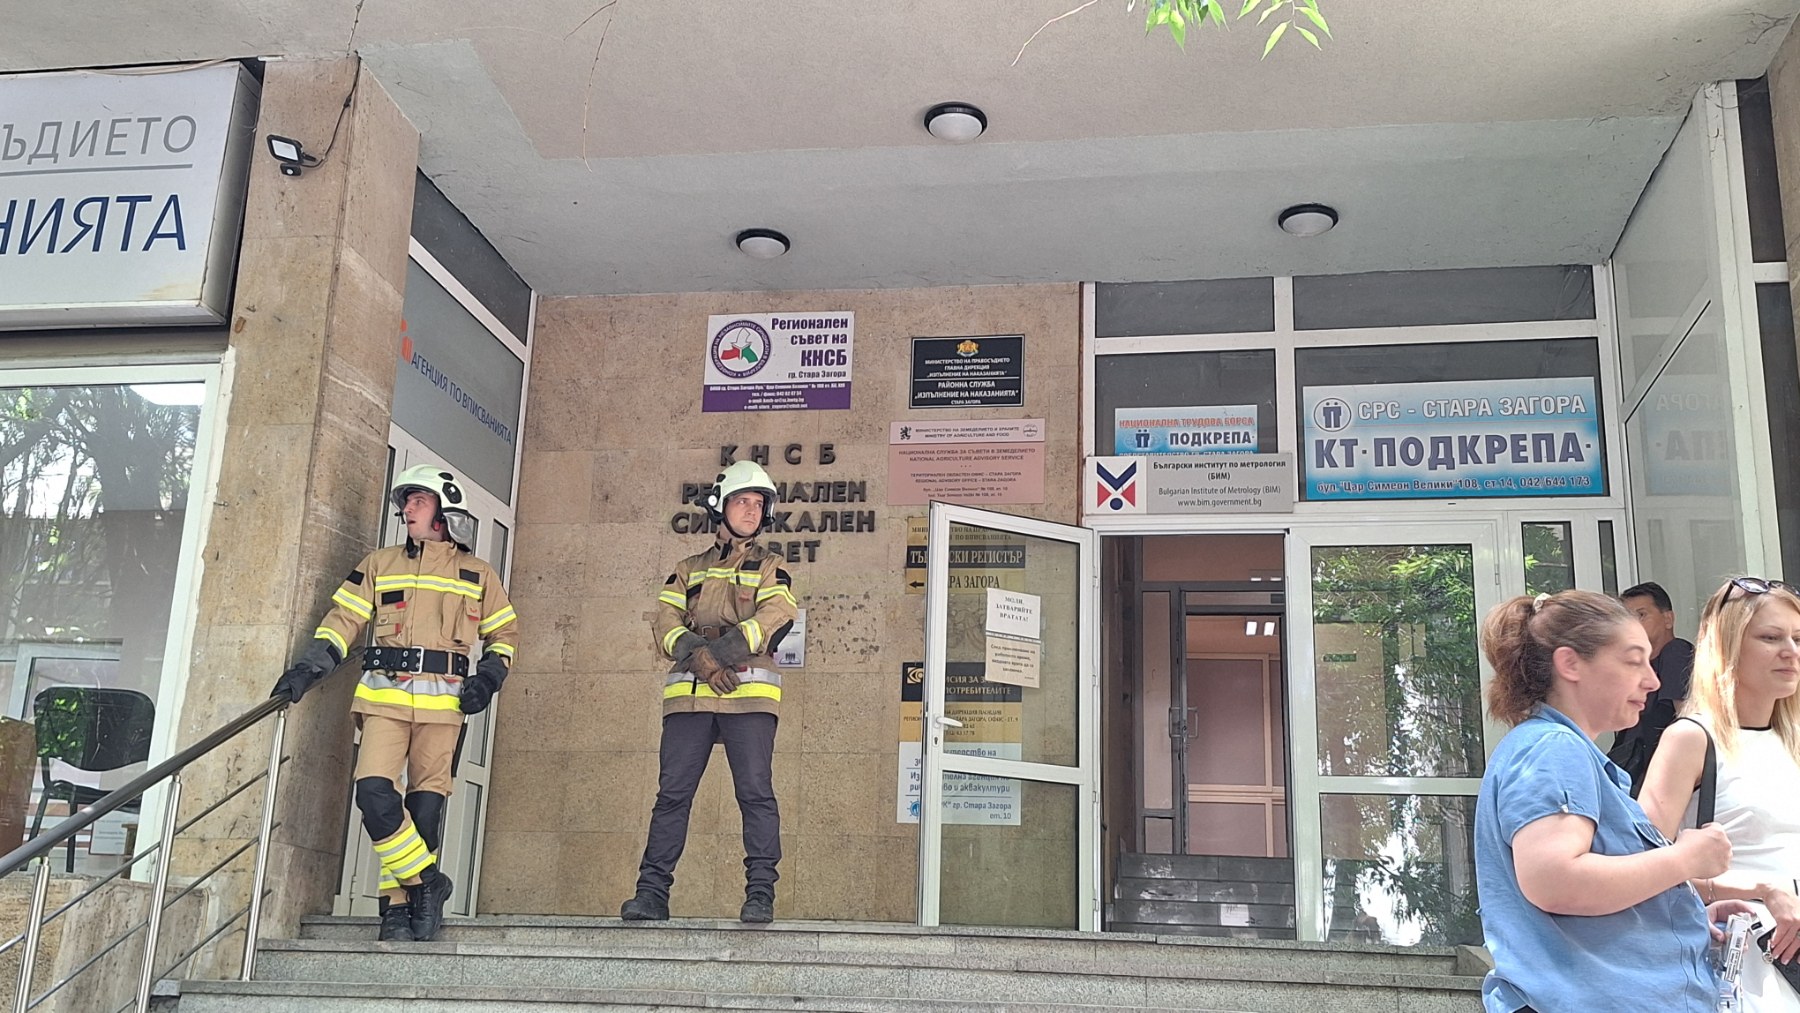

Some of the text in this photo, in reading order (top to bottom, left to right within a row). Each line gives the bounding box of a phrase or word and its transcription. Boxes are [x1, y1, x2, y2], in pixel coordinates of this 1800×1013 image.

[771, 317, 849, 330] Регионален
[790, 333, 848, 345] съвет на
[800, 349, 847, 367] КНСБ
[821, 370, 847, 378] Загора
[938, 381, 968, 389] РАЙОННА
[411, 352, 512, 445] АГЕНЦИЯ ПО ВПИСВАНИЯТА
[1357, 401, 1401, 420] СРС
[1423, 397, 1493, 418] СТАРА
[1498, 394, 1586, 416] ЗАГОРА
[1119, 416, 1255, 429] НАЦИОНАЛНА ТРУДОВА БОРСА
[1153, 462, 1193, 471] Български
[1194, 462, 1228, 470] институт
[1240, 460, 1286, 470] метрология
[1208, 472, 1230, 481] (БИМ)
[1367, 480, 1410, 491] Симеон
[1569, 476, 1590, 486] 173
[1158, 486, 1281, 497] Bulgarian Institute of Metrology (BIM)
[1177, 498, 1262, 508] www.bim.government.bg
[971, 550, 1023, 563] РЕГИСТЪР
[964, 575, 1000, 588] ЗАГОРА
[968, 676, 979, 684] ЗА
[960, 783, 1010, 794] аквакултури
[963, 802, 986, 810] Стара
[987, 802, 1012, 811] Загора
